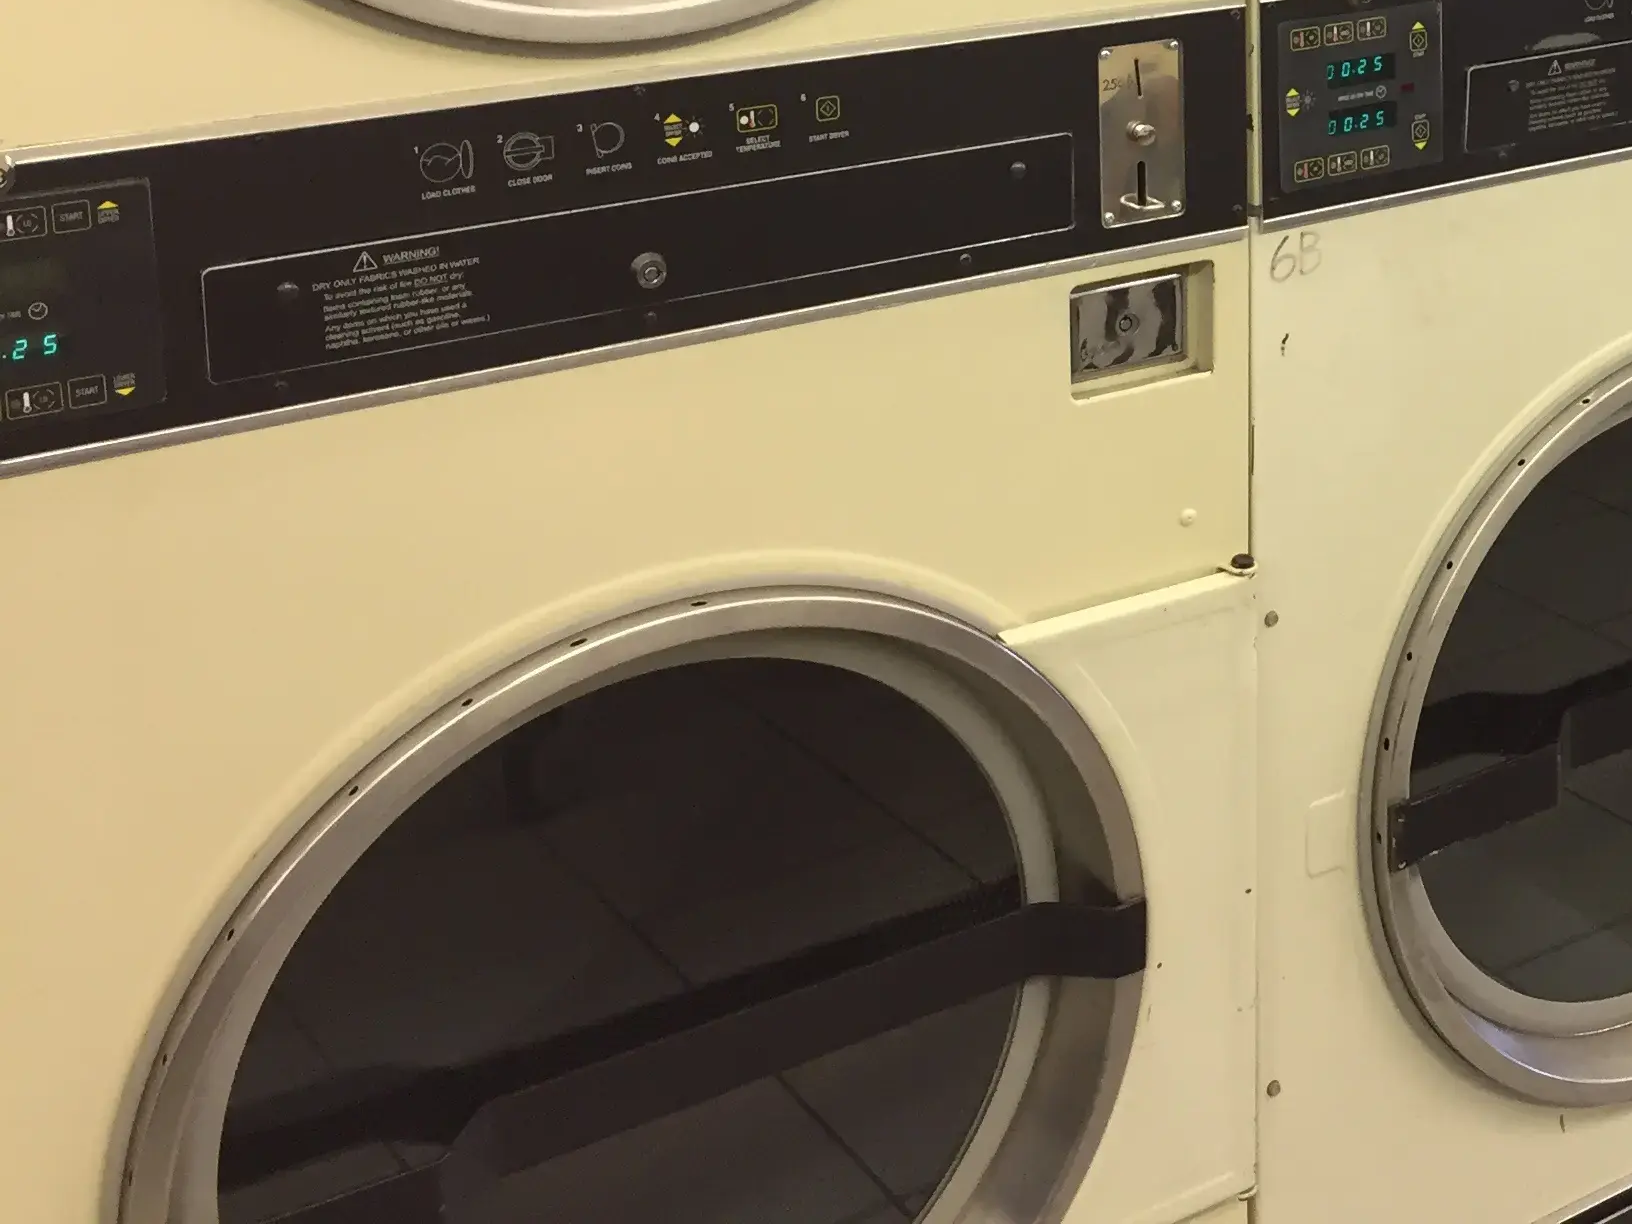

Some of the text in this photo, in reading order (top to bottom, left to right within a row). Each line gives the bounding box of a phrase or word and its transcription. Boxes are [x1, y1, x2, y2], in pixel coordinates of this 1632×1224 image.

[496, 134, 503, 144] 2
[413, 145, 419, 154] 1
[59, 211, 83, 223] START
[382, 246, 440, 264] WARNING!
[1269, 231, 1322, 283] 6B
[311, 281, 331, 292] DRY
[333, 278, 357, 288] ONLY
[399, 264, 438, 276] WASHED
[449, 257, 480, 269] WATER
[75, 385, 99, 397] START
